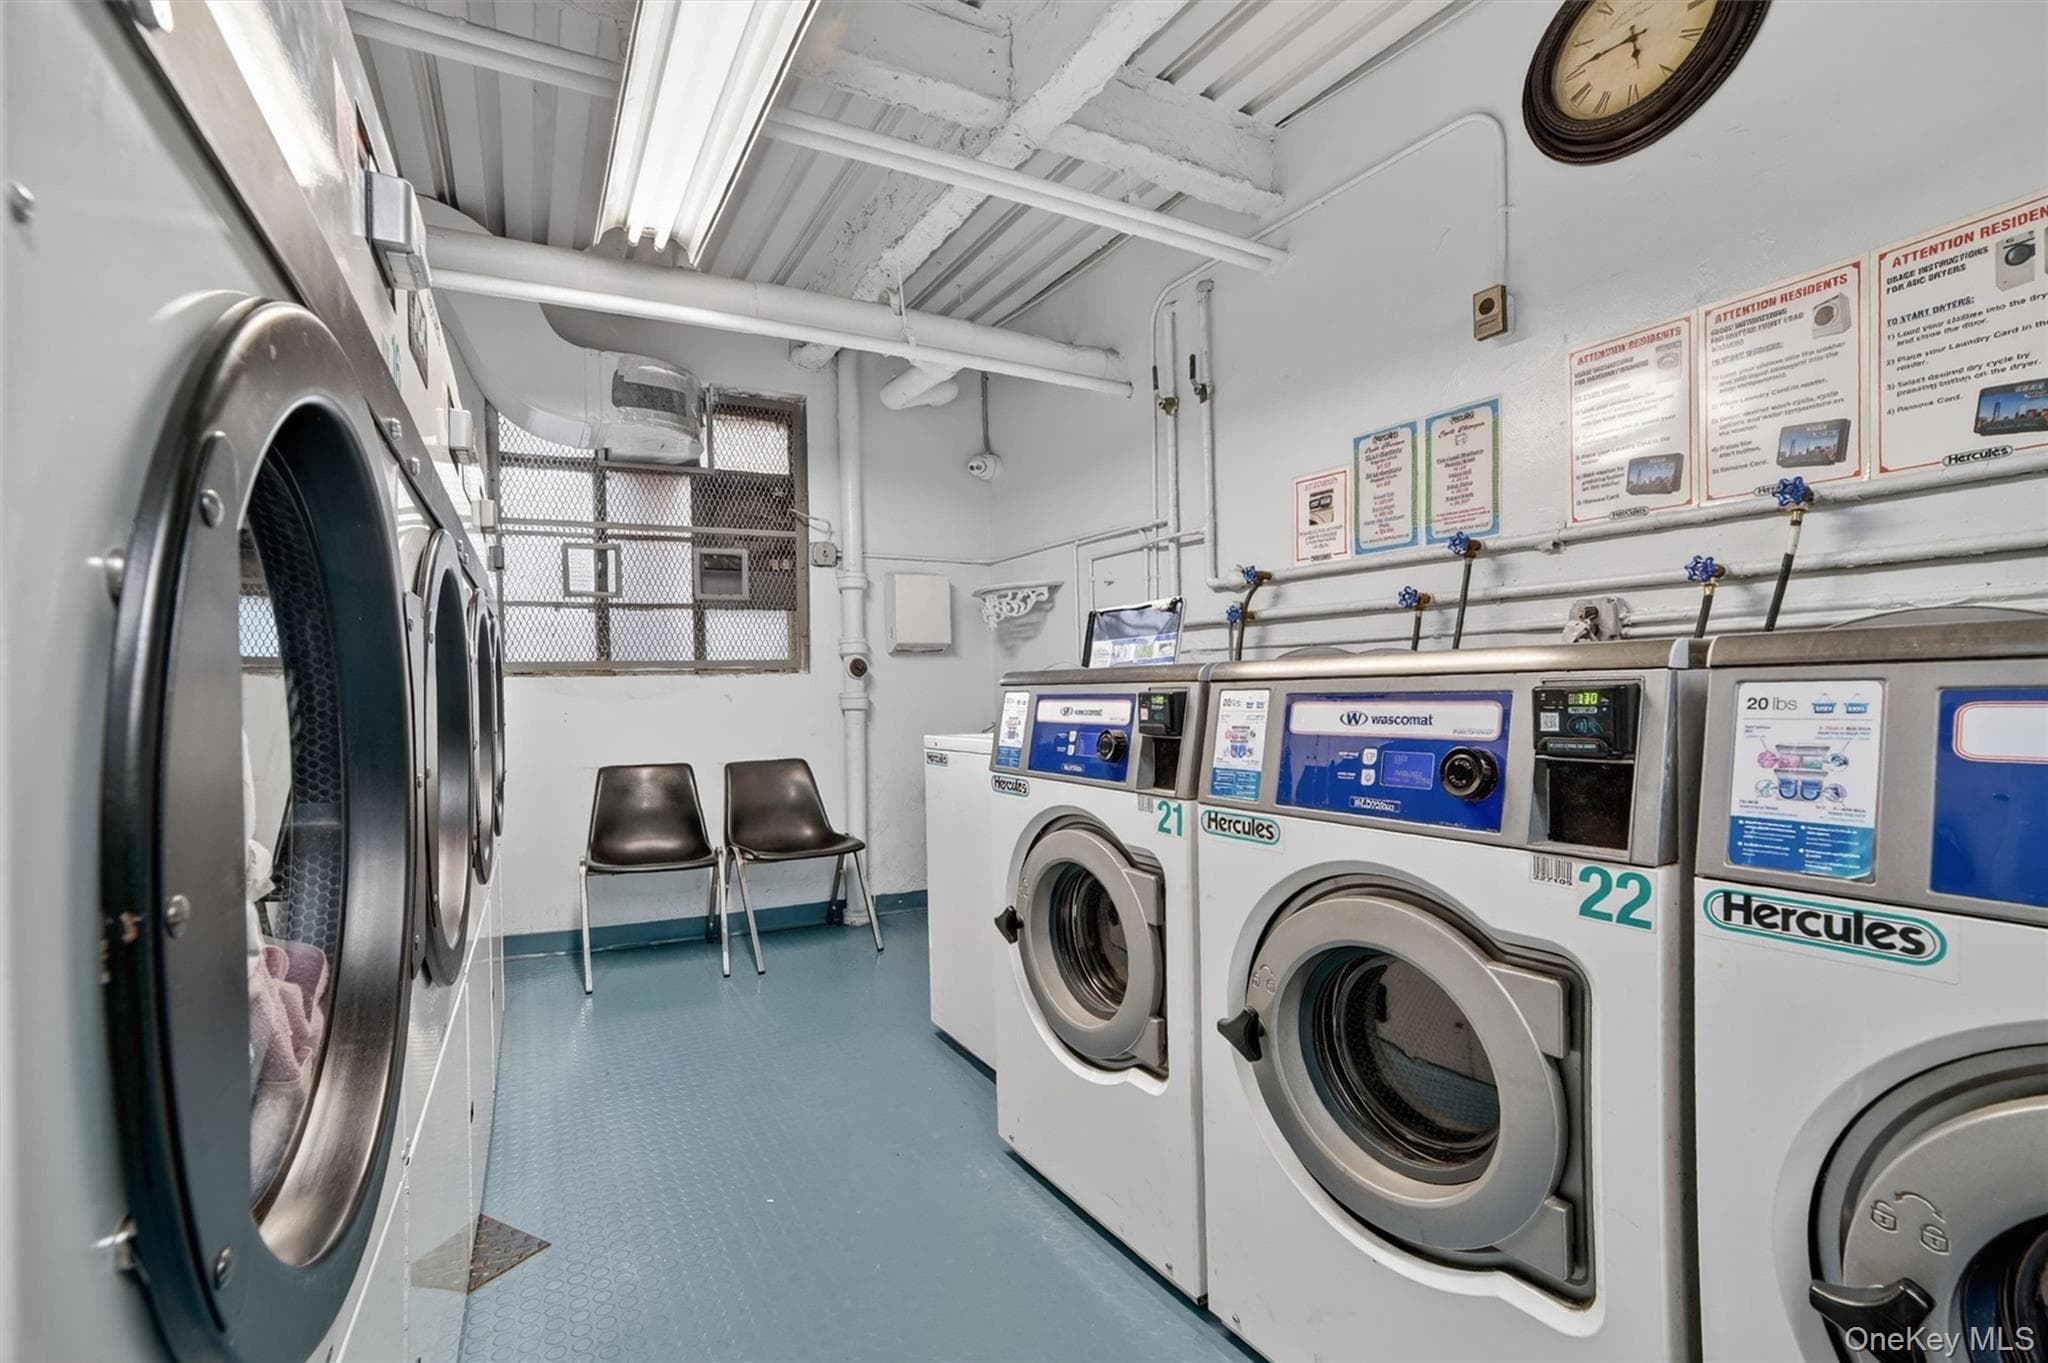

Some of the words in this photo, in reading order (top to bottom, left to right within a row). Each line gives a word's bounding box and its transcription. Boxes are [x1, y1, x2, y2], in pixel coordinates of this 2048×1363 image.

[1892, 231, 1975, 269] ATTENTION
[1918, 246, 1989, 275] INSTRUCTIONS
[1715, 297, 1777, 324] ATTENTION
[1780, 273, 1848, 305] RESIDENTS
[2009, 297, 2026, 308] the
[2029, 291, 2048, 304] dry
[1949, 334, 1990, 350] Laundry
[1993, 327, 2019, 339] Card
[2021, 323, 2033, 331] in
[1986, 355, 2014, 367] cycle
[2016, 351, 2031, 361] by
[1990, 366, 2007, 375] the
[1948, 446, 2010, 465] Hercules
[1746, 696, 1769, 711] 20
[1772, 696, 1798, 711] lbs
[1370, 713, 1434, 727] wascomat
[993, 775, 1027, 794] Hercules
[1157, 800, 1183, 837] 21
[1207, 810, 1275, 840] Hercules
[1578, 865, 1652, 930] 22
[1722, 891, 1926, 957] Hercules
